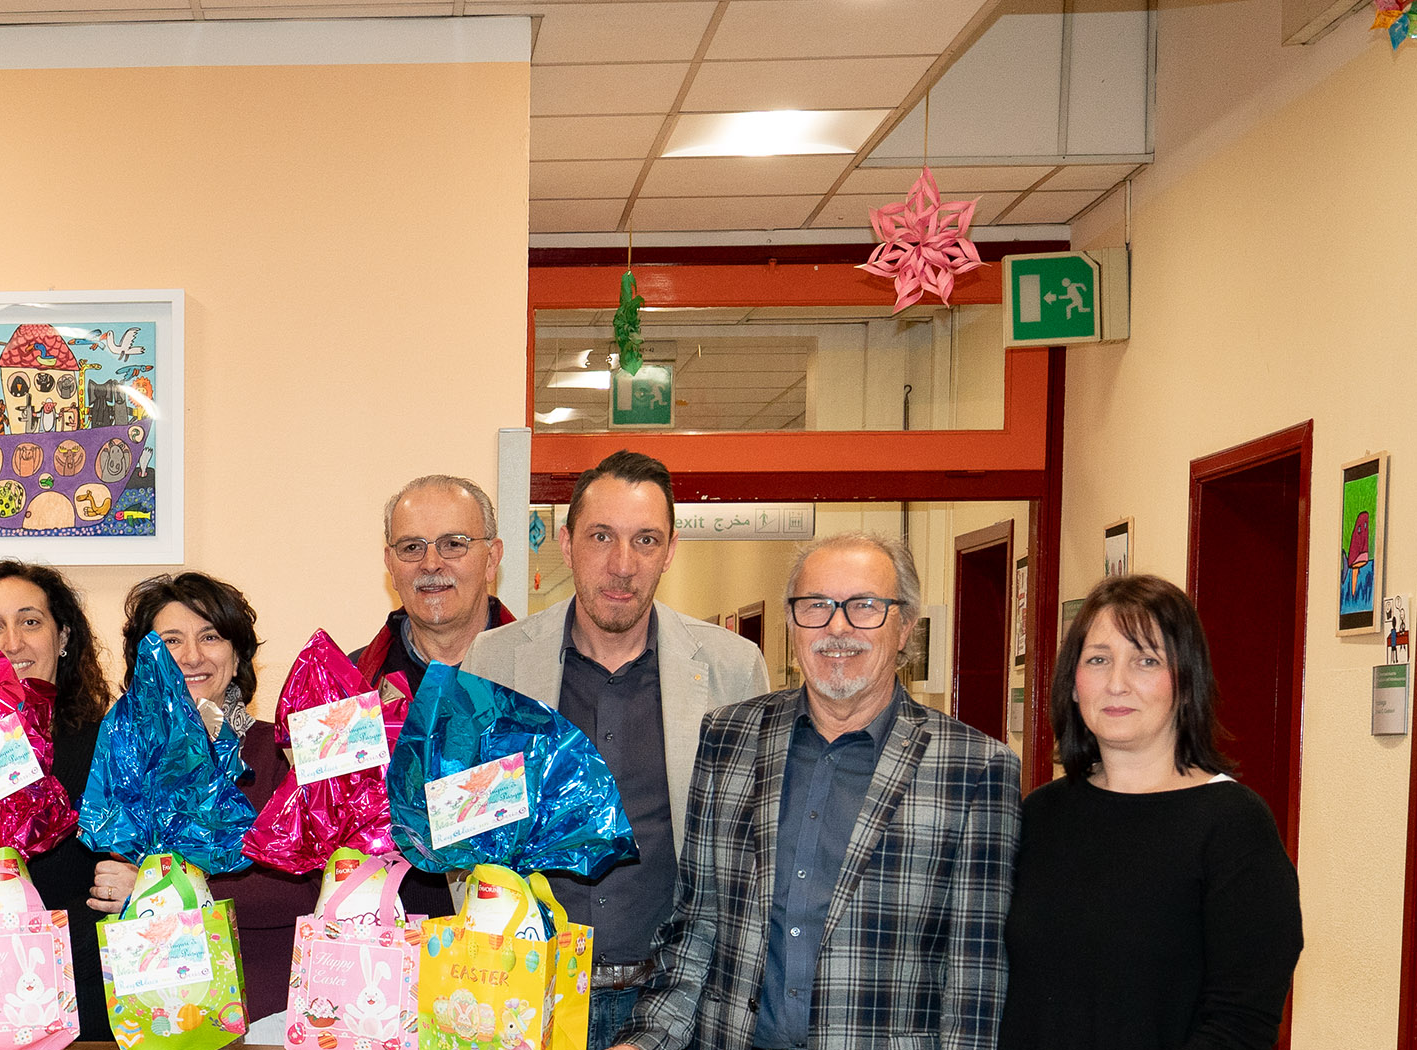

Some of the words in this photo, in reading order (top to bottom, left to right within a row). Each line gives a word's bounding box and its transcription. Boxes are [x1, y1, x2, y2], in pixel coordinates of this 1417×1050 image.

[674, 514, 705, 529] exit
[312, 950, 355, 970] Happy
[312, 969, 348, 986] Easter
[450, 964, 509, 987] EASTER
